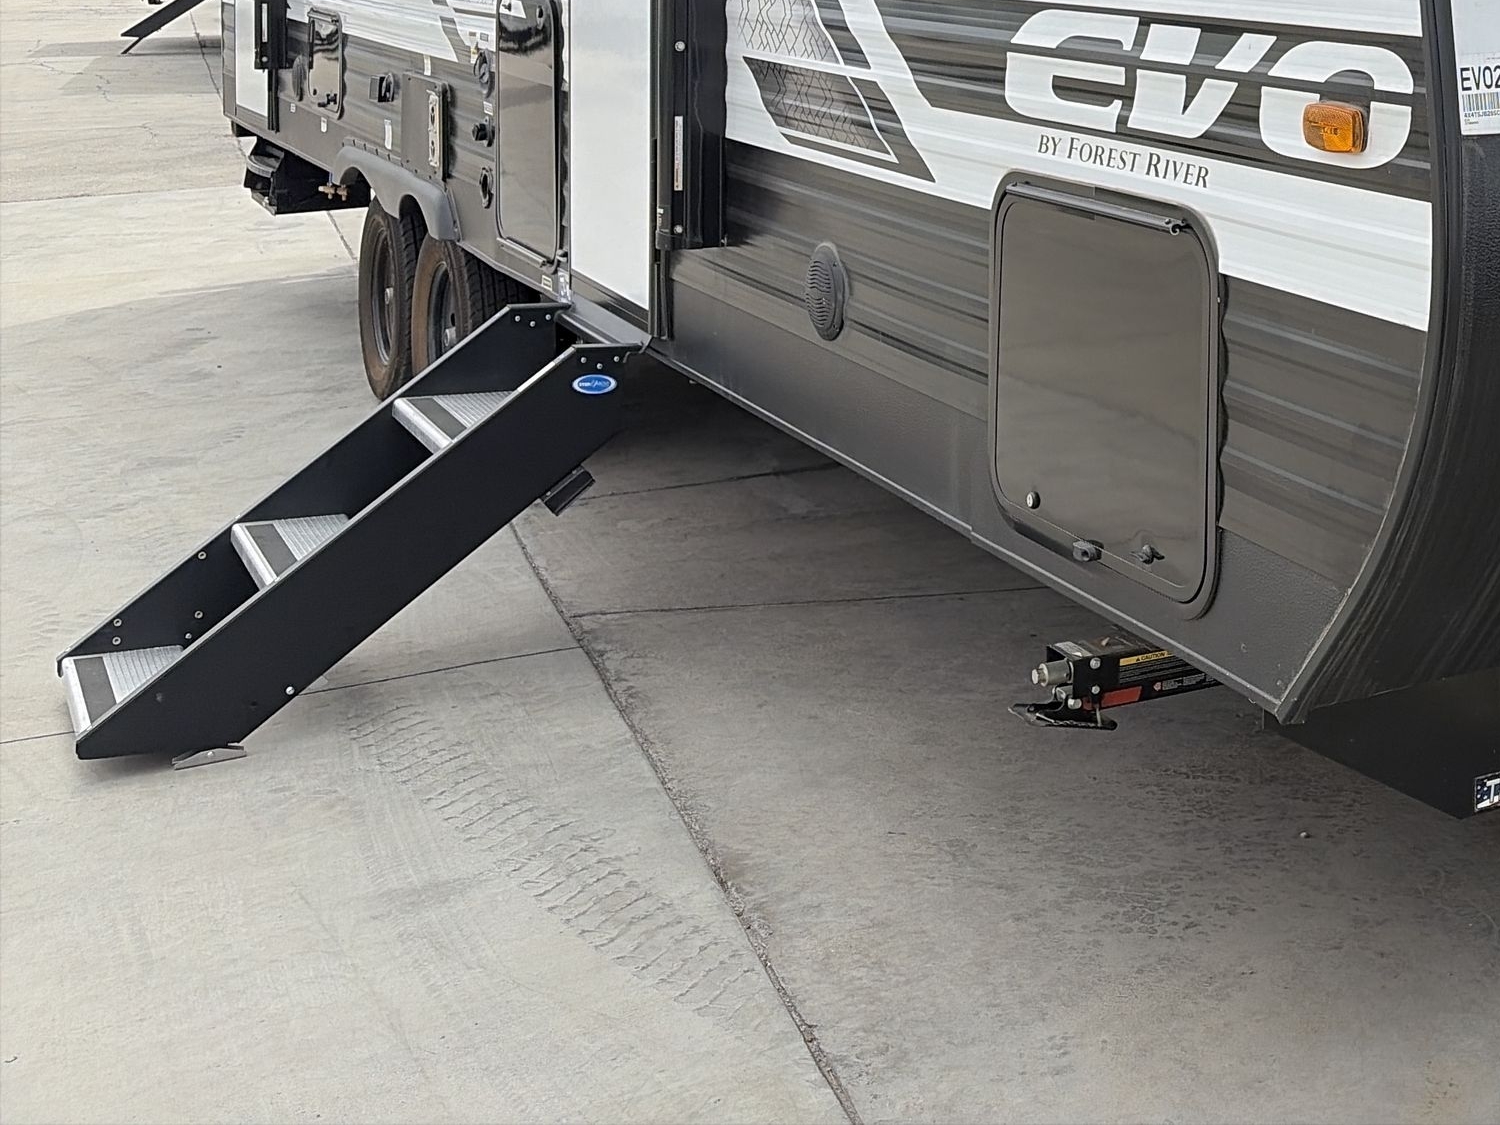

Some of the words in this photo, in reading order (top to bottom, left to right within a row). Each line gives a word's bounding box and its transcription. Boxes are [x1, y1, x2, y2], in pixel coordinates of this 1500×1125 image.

[1005, 8, 1414, 169] EVO
[1037, 134, 1062, 155] BY
[1066, 137, 1142, 173] FOREST
[1144, 152, 1210, 189] RIVER
[1140, 651, 1166, 661] CAUTION
